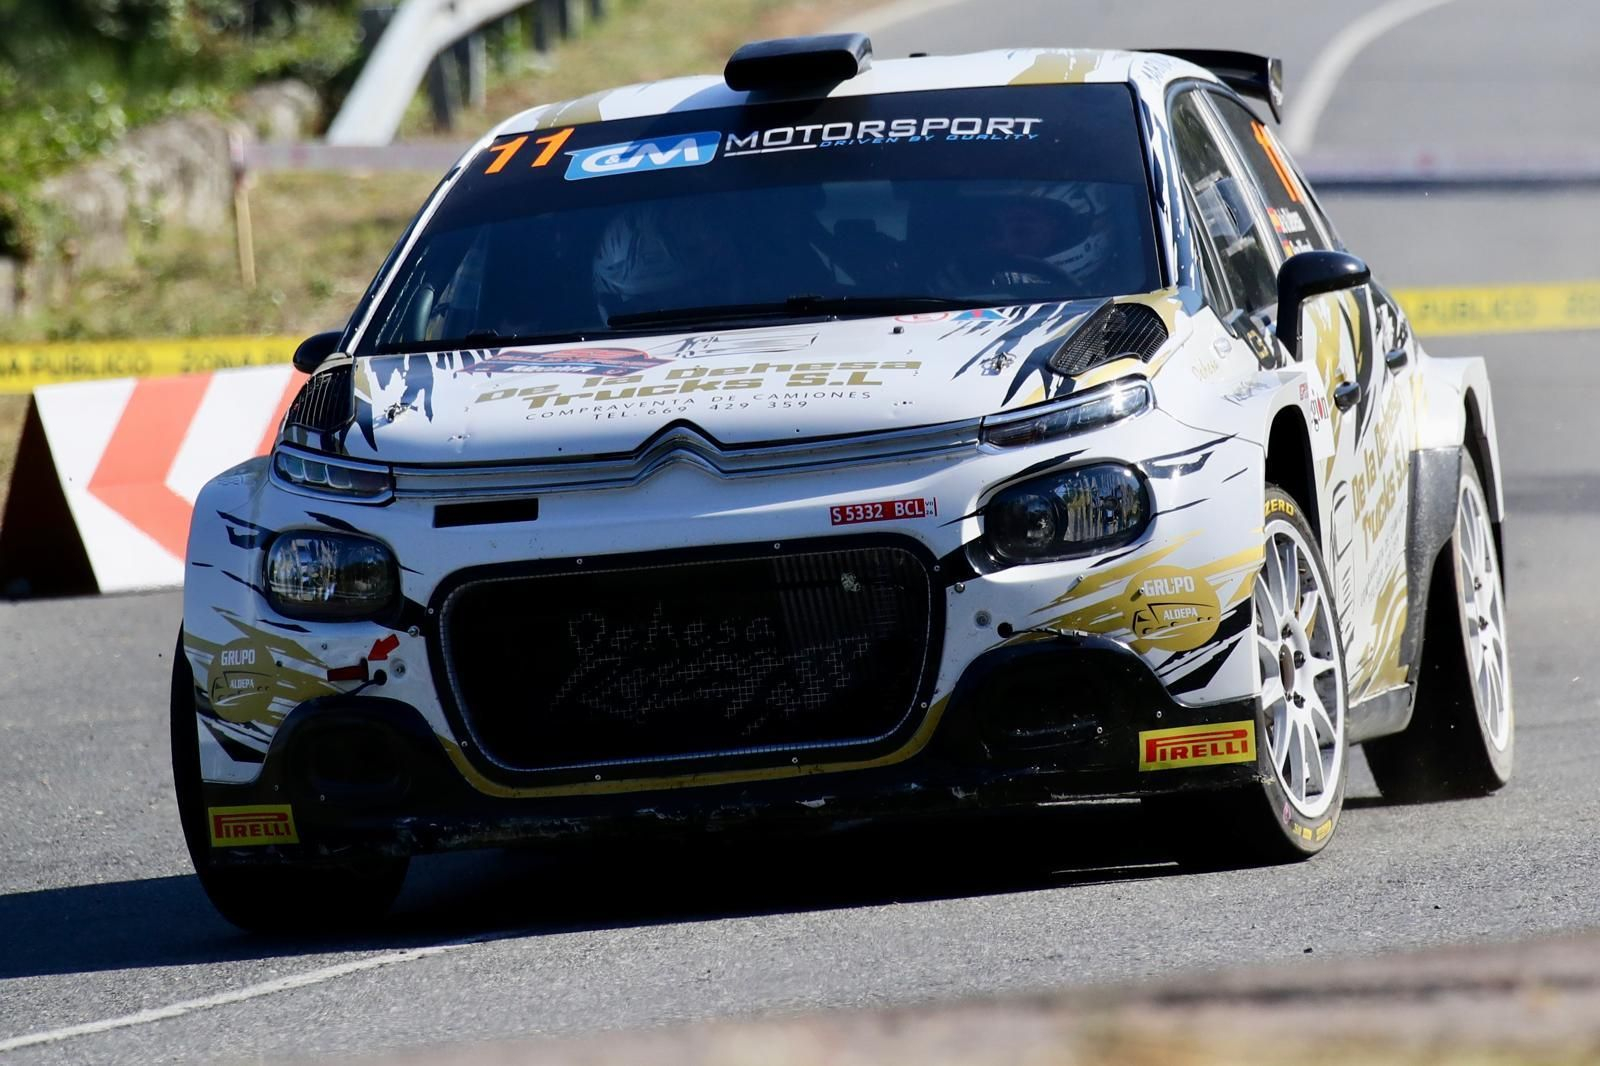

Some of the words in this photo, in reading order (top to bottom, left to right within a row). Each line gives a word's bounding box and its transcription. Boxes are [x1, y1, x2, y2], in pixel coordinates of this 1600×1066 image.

[484, 127, 575, 175] 11
[725, 117, 1043, 151] MOTORSPORT
[819, 136, 900, 148] DRIVEN
[908, 134, 934, 143] BY
[946, 133, 1039, 141] QUALITY
[474, 384, 560, 404] De
[582, 374, 644, 389] la
[664, 360, 923, 381] Dehesa
[522, 377, 765, 410] Trucks
[525, 398, 696, 421] COMPRAVENTA
[711, 394, 737, 403] DE
[753, 391, 872, 400] CAMIONES
[593, 412, 638, 420] TEL.
[647, 405, 688, 415] 669
[708, 401, 750, 411] 429
[767, 400, 808, 409] 359
[832, 507, 842, 523] S
[846, 503, 884, 521] 5332
[894, 500, 923, 517] BCL
[1264, 498, 1295, 517] ZERO
[1143, 575, 1196, 596] GRUPO
[1163, 607, 1198, 621] ALDEPA
[220, 649, 256, 666] GRUPO
[229, 678, 255, 689] ALDEPA
[1145, 728, 1249, 763] PIRELLI
[212, 811, 292, 840] PIRELLI
